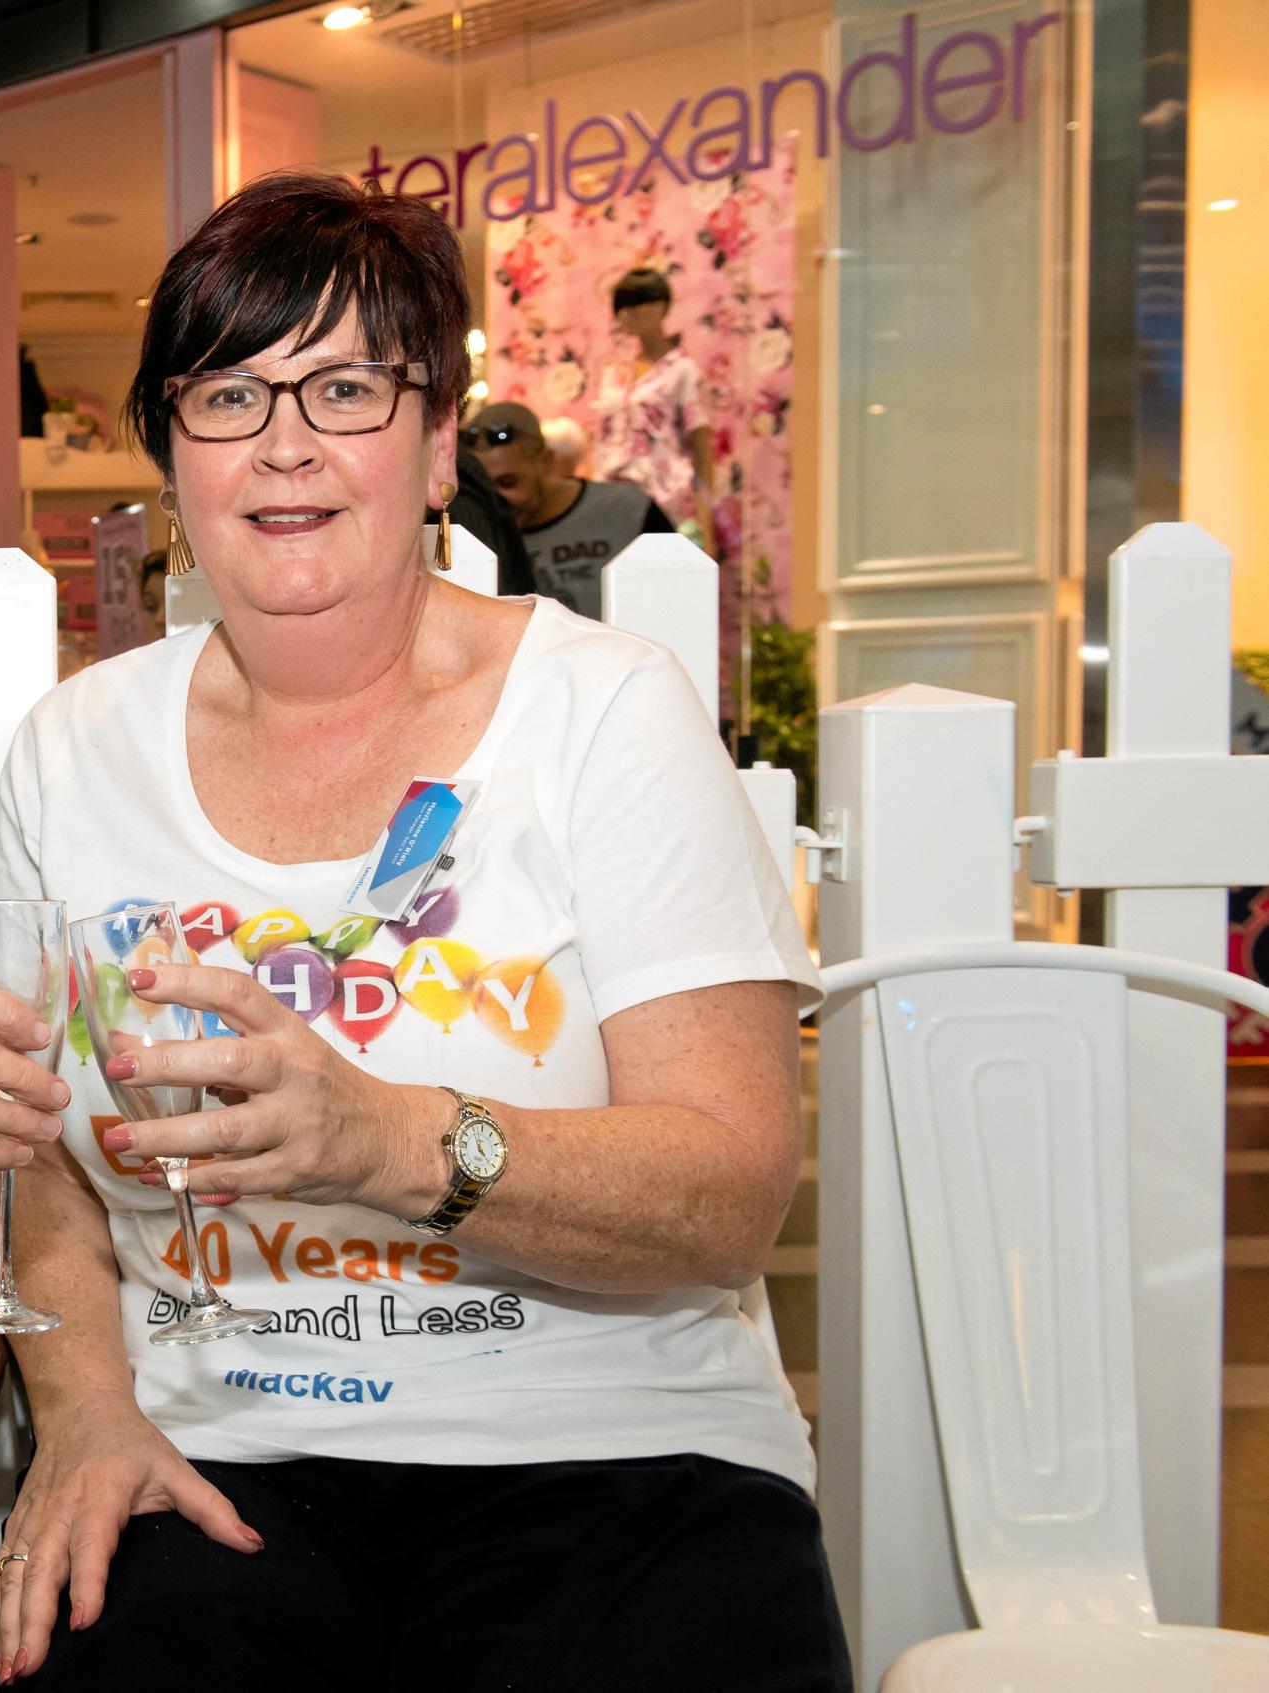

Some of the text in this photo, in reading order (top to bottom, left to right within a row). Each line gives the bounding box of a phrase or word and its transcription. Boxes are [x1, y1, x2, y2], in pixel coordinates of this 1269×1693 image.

[552, 539, 610, 564] DAD
[247, 1221, 461, 1284] Years
[381, 1292, 526, 1338] Less
